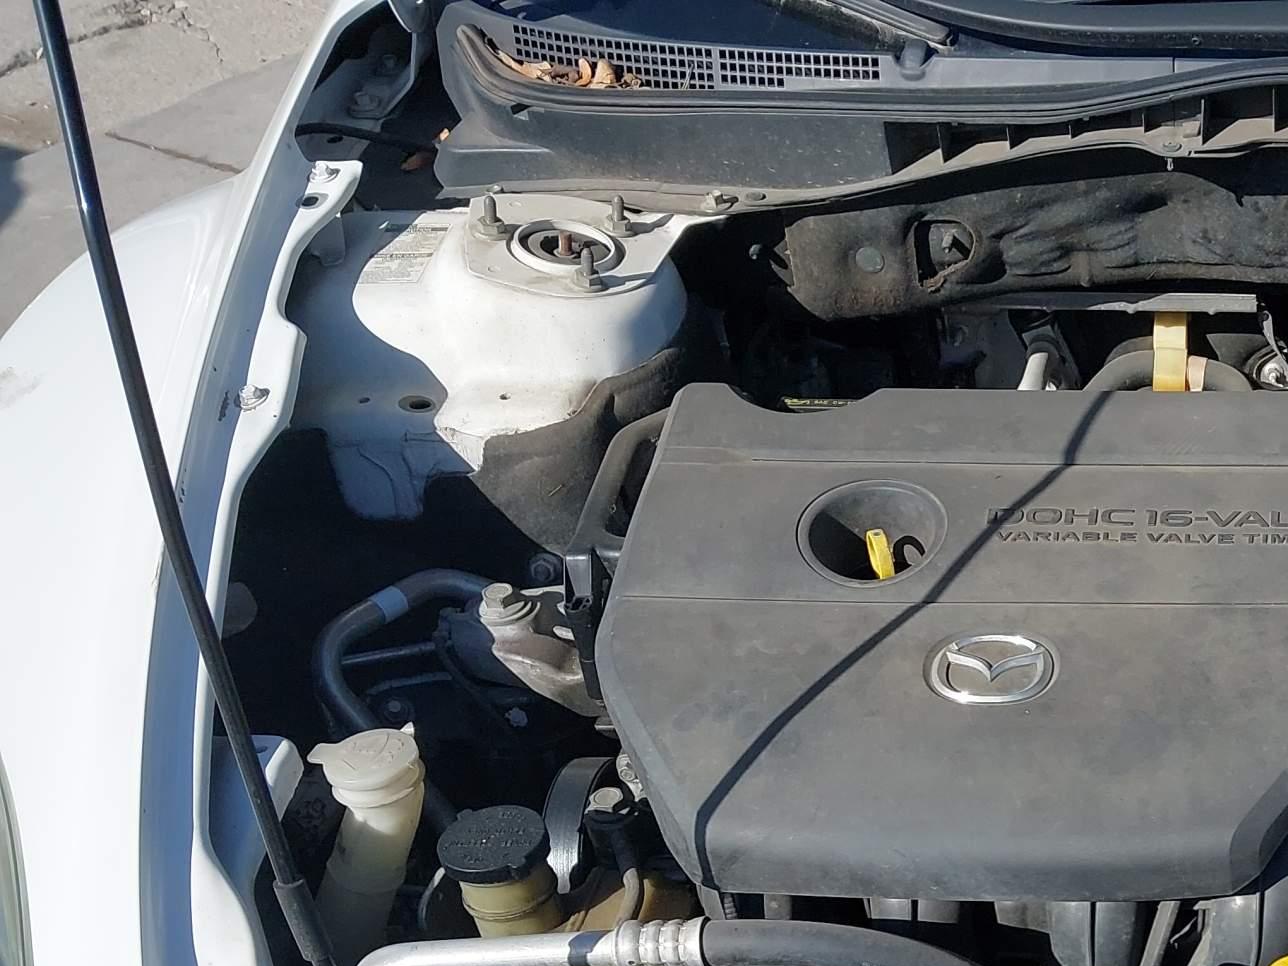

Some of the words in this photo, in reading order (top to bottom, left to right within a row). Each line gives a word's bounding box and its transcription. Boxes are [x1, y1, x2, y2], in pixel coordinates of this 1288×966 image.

[986, 508, 1136, 526] DOHC
[999, 531, 1138, 542] VARIABLE
[1146, 532, 1235, 544] VALVE
